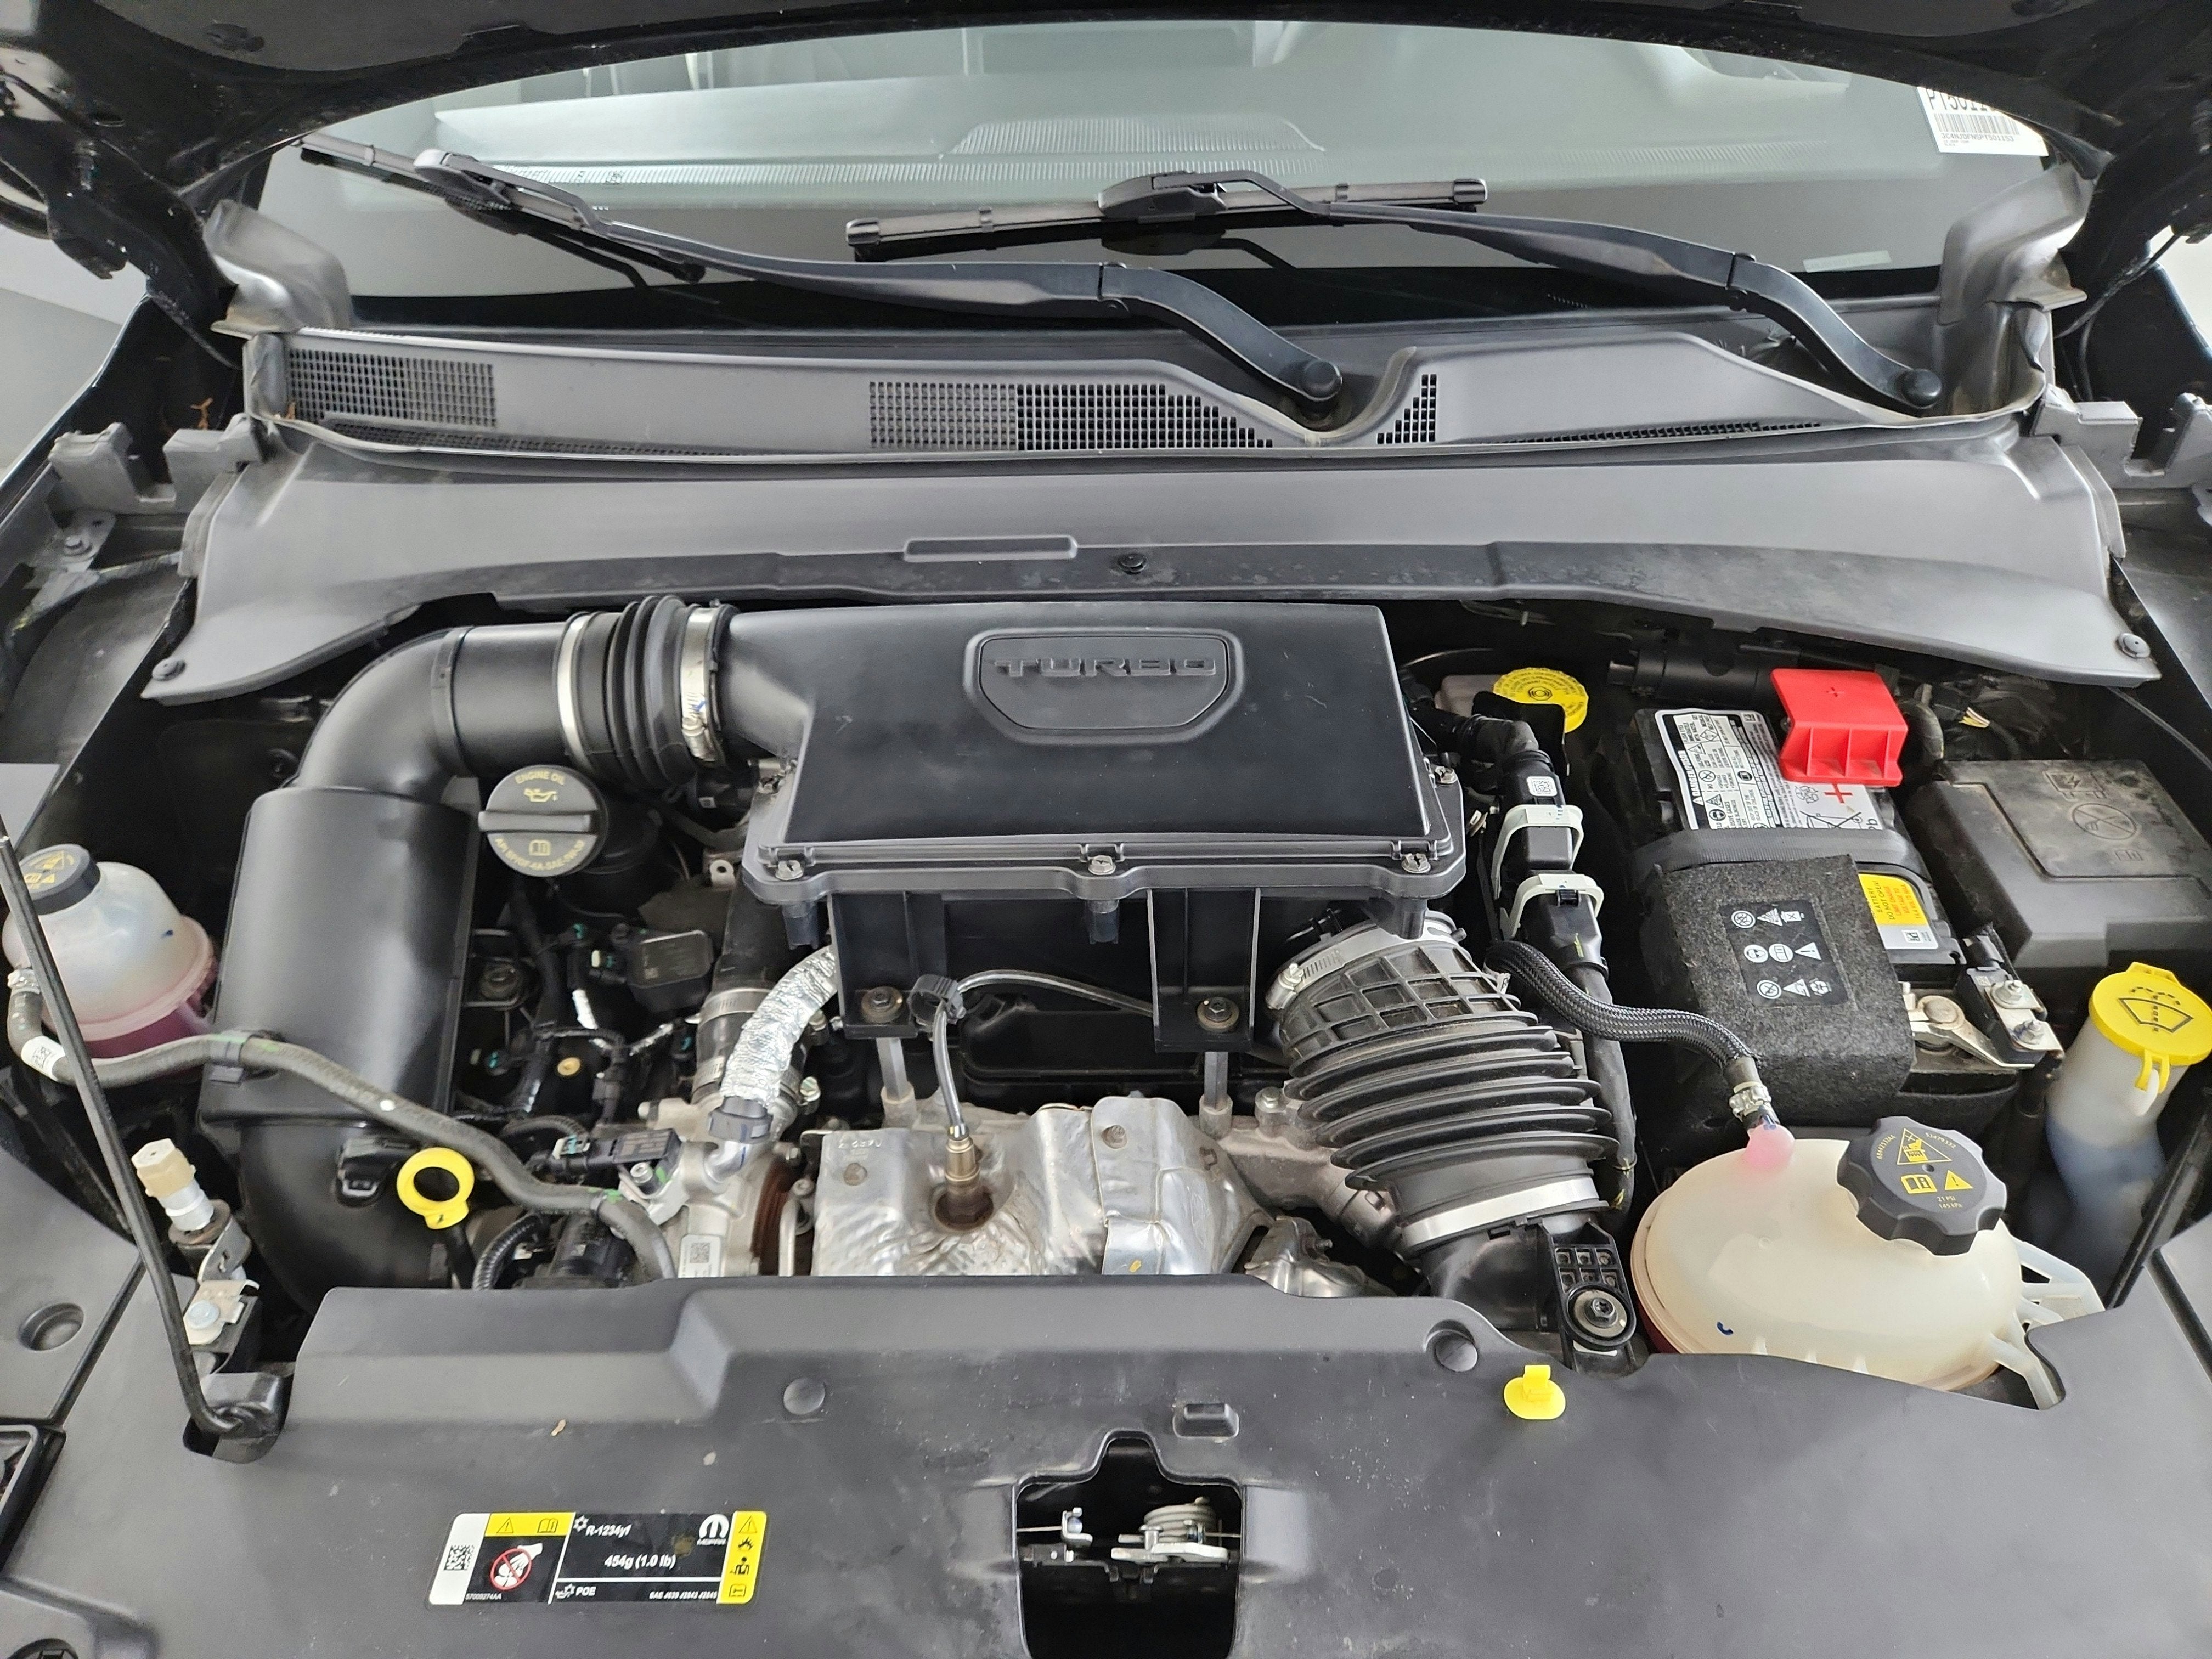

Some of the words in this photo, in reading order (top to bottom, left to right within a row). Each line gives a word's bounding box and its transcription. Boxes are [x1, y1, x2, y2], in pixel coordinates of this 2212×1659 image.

[985, 657, 1217, 678] TURBO
[515, 770, 550, 784] ENGINE
[550, 772, 566, 786] OIL
[1867, 888, 1882, 912] BATTERY
[1880, 899, 1891, 910] NOT
[1886, 911, 1895, 919] DO
[585, 1523, 633, 1538] R-1234yf
[604, 1555, 633, 1570] 454g
[635, 1554, 658, 1570] (1.0
[659, 1554, 677, 1570] lb)
[576, 1585, 596, 1596] POE
